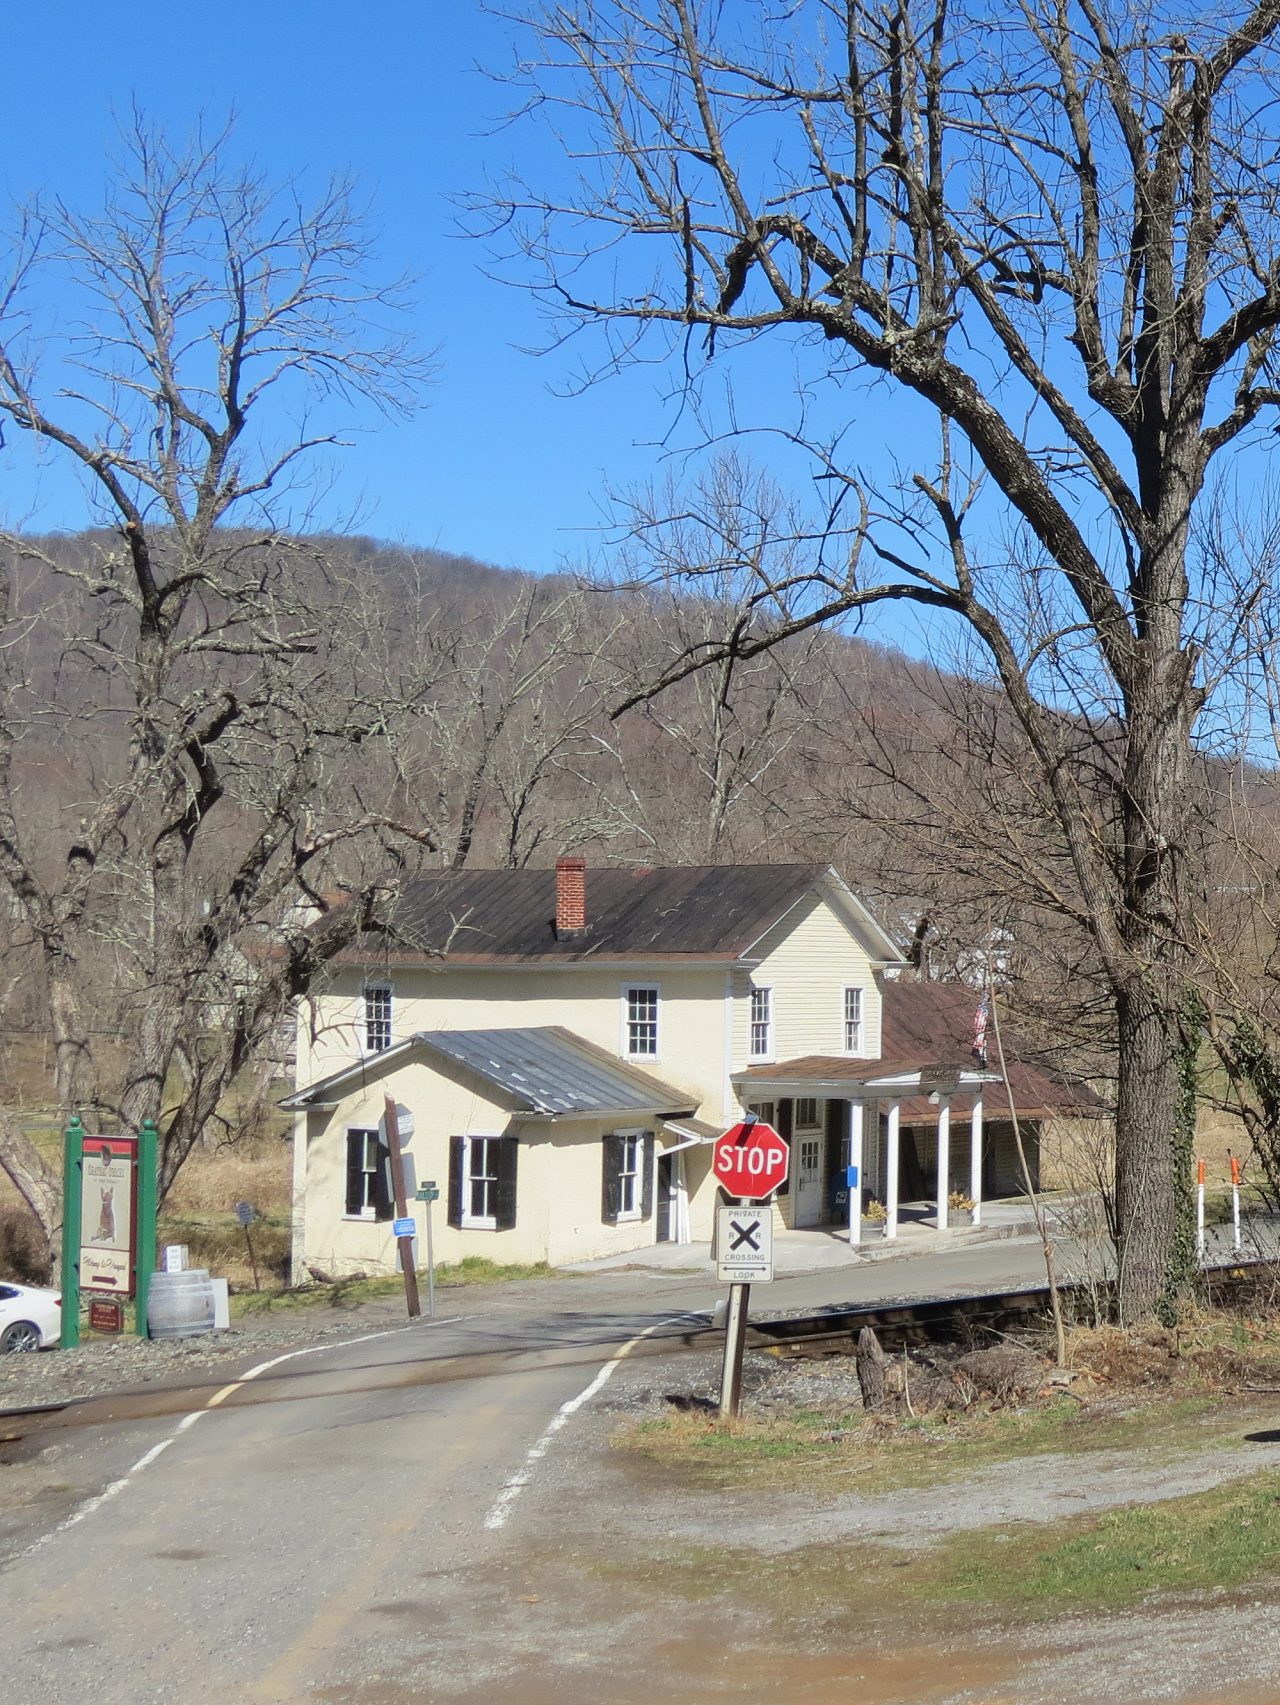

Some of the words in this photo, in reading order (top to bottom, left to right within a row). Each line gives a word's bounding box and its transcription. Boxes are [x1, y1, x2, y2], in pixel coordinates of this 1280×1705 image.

[717, 1144, 784, 1176] STOP
[728, 1210, 762, 1218] PRIVATE
[755, 1232, 762, 1240] R
[724, 1253, 766, 1262] CROSSING
[733, 1271, 756, 1280] LOOK
